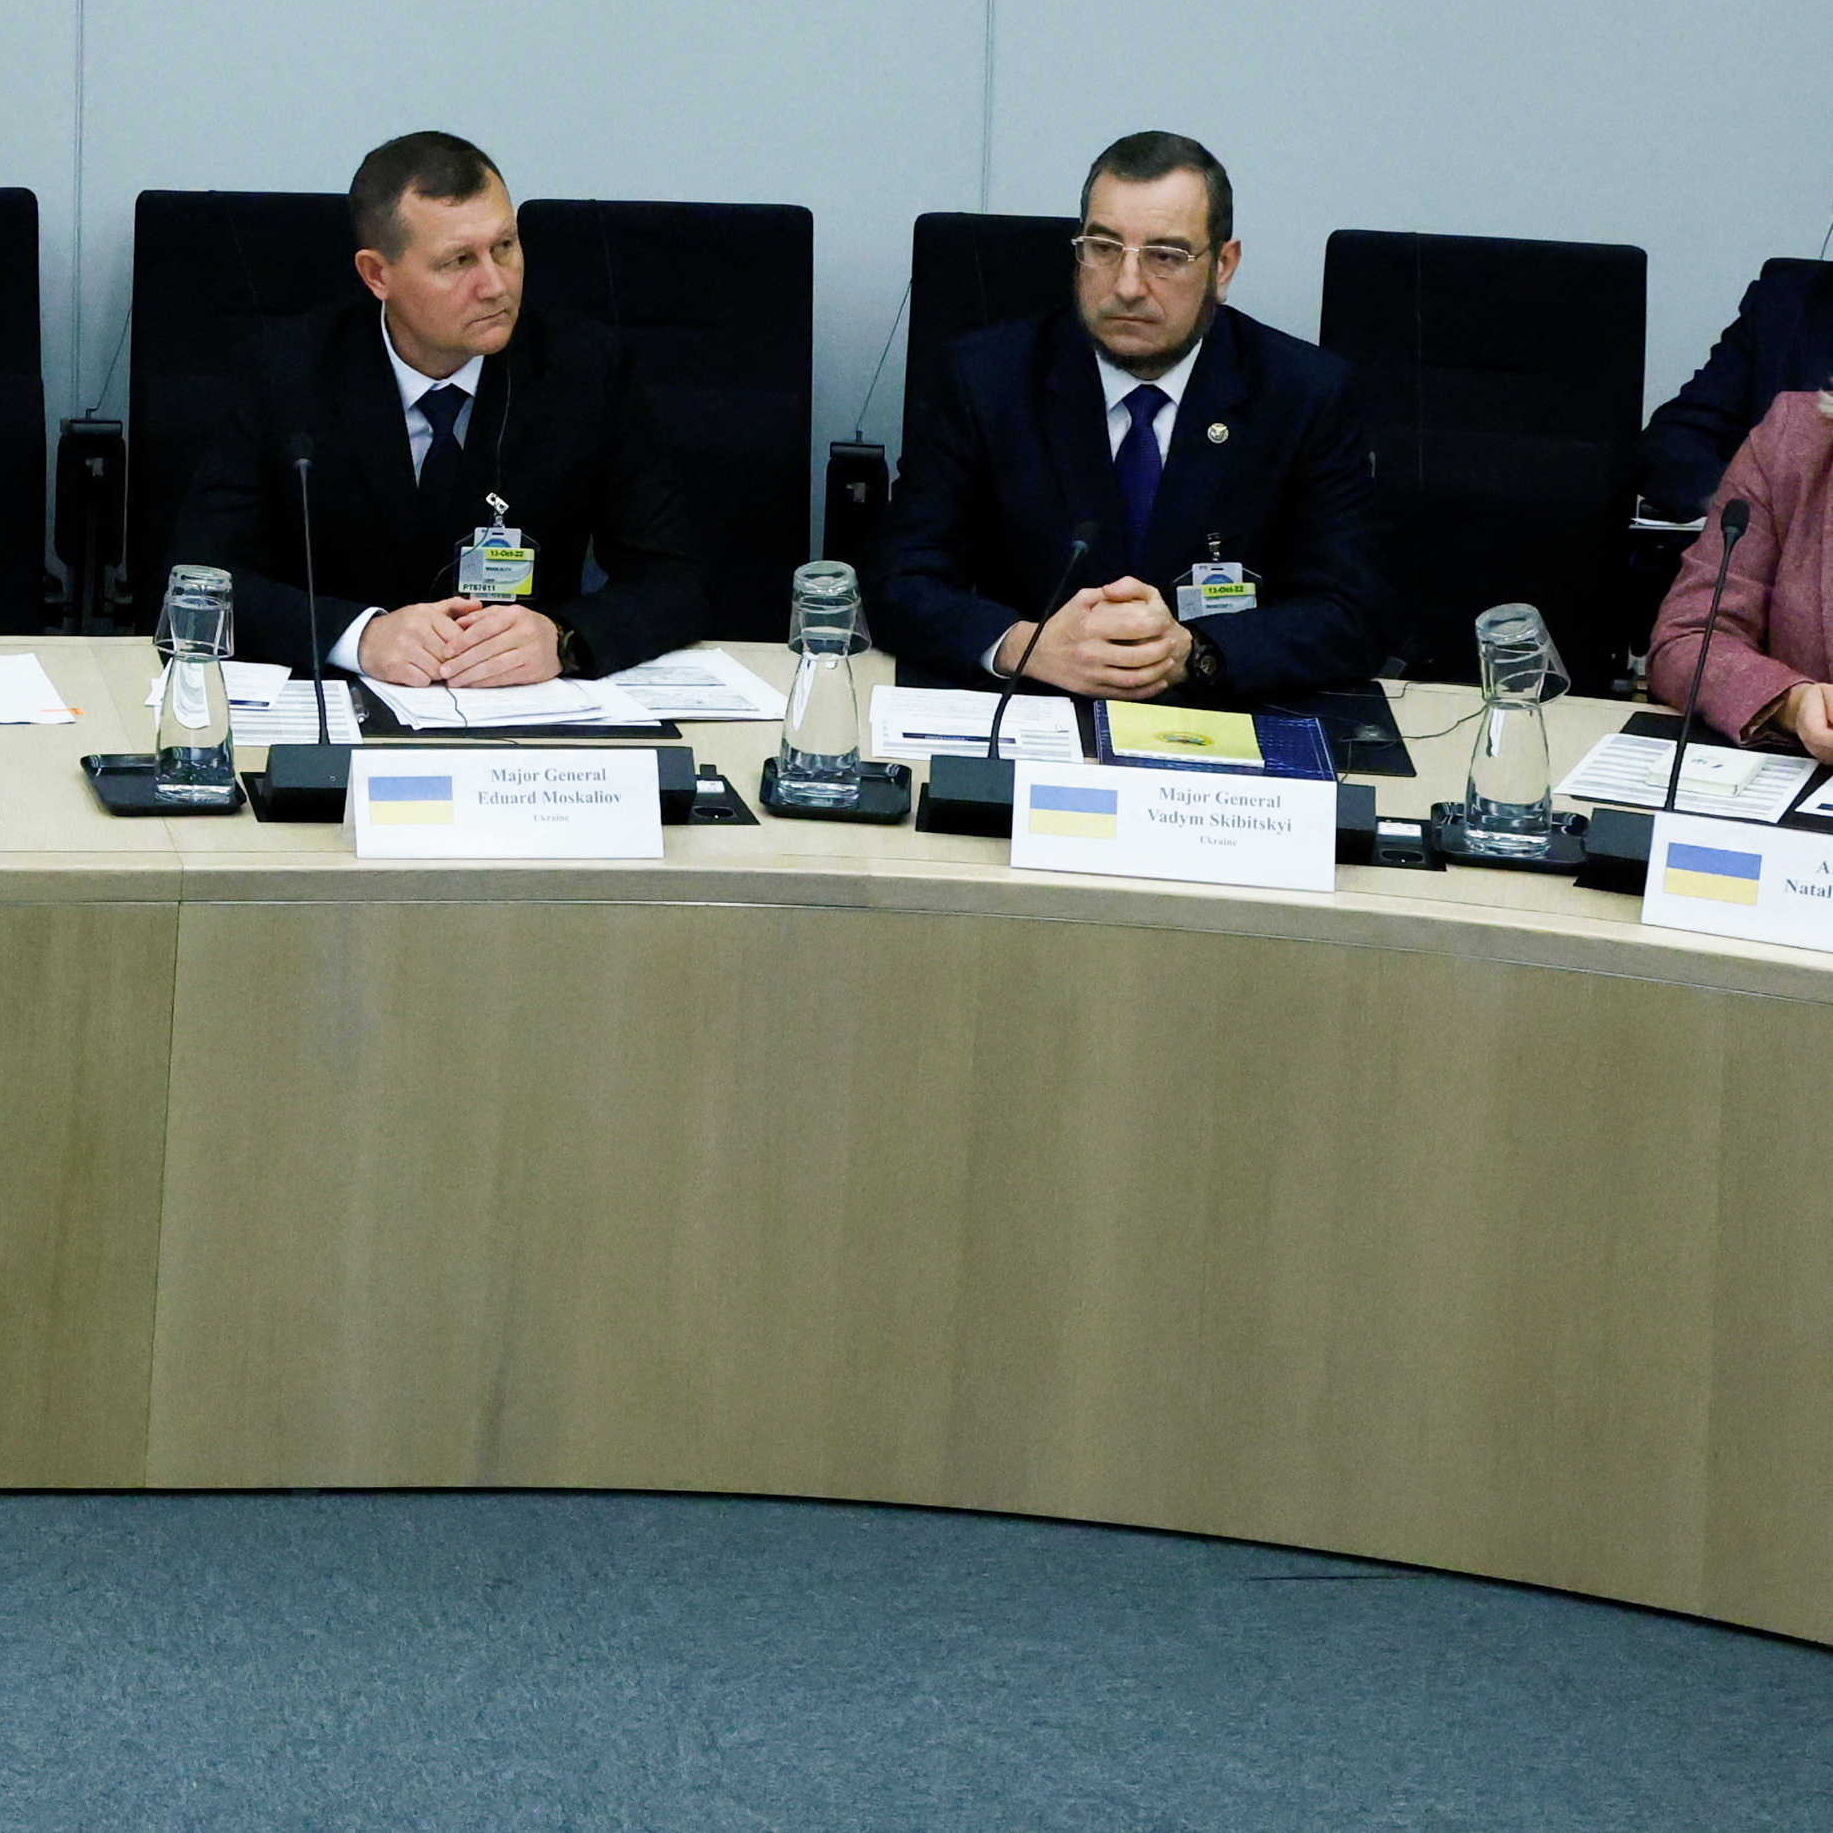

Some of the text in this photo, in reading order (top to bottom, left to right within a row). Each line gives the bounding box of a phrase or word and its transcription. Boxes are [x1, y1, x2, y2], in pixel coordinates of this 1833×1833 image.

[490, 549, 525, 558] 13-Oct-22
[1208, 584, 1245, 594] 13-Oct-22
[491, 767, 607, 786] Major General
[477, 790, 622, 805] Eduard Moskaliov
[1159, 786, 1281, 809] Major General
[532, 813, 570, 822] Ukraine
[1147, 808, 1293, 835] Vadym Skibitskyi
[1199, 835, 1238, 847] Ukraine
[1816, 860, 1833, 875] A
[1784, 878, 1833, 899] Natal
